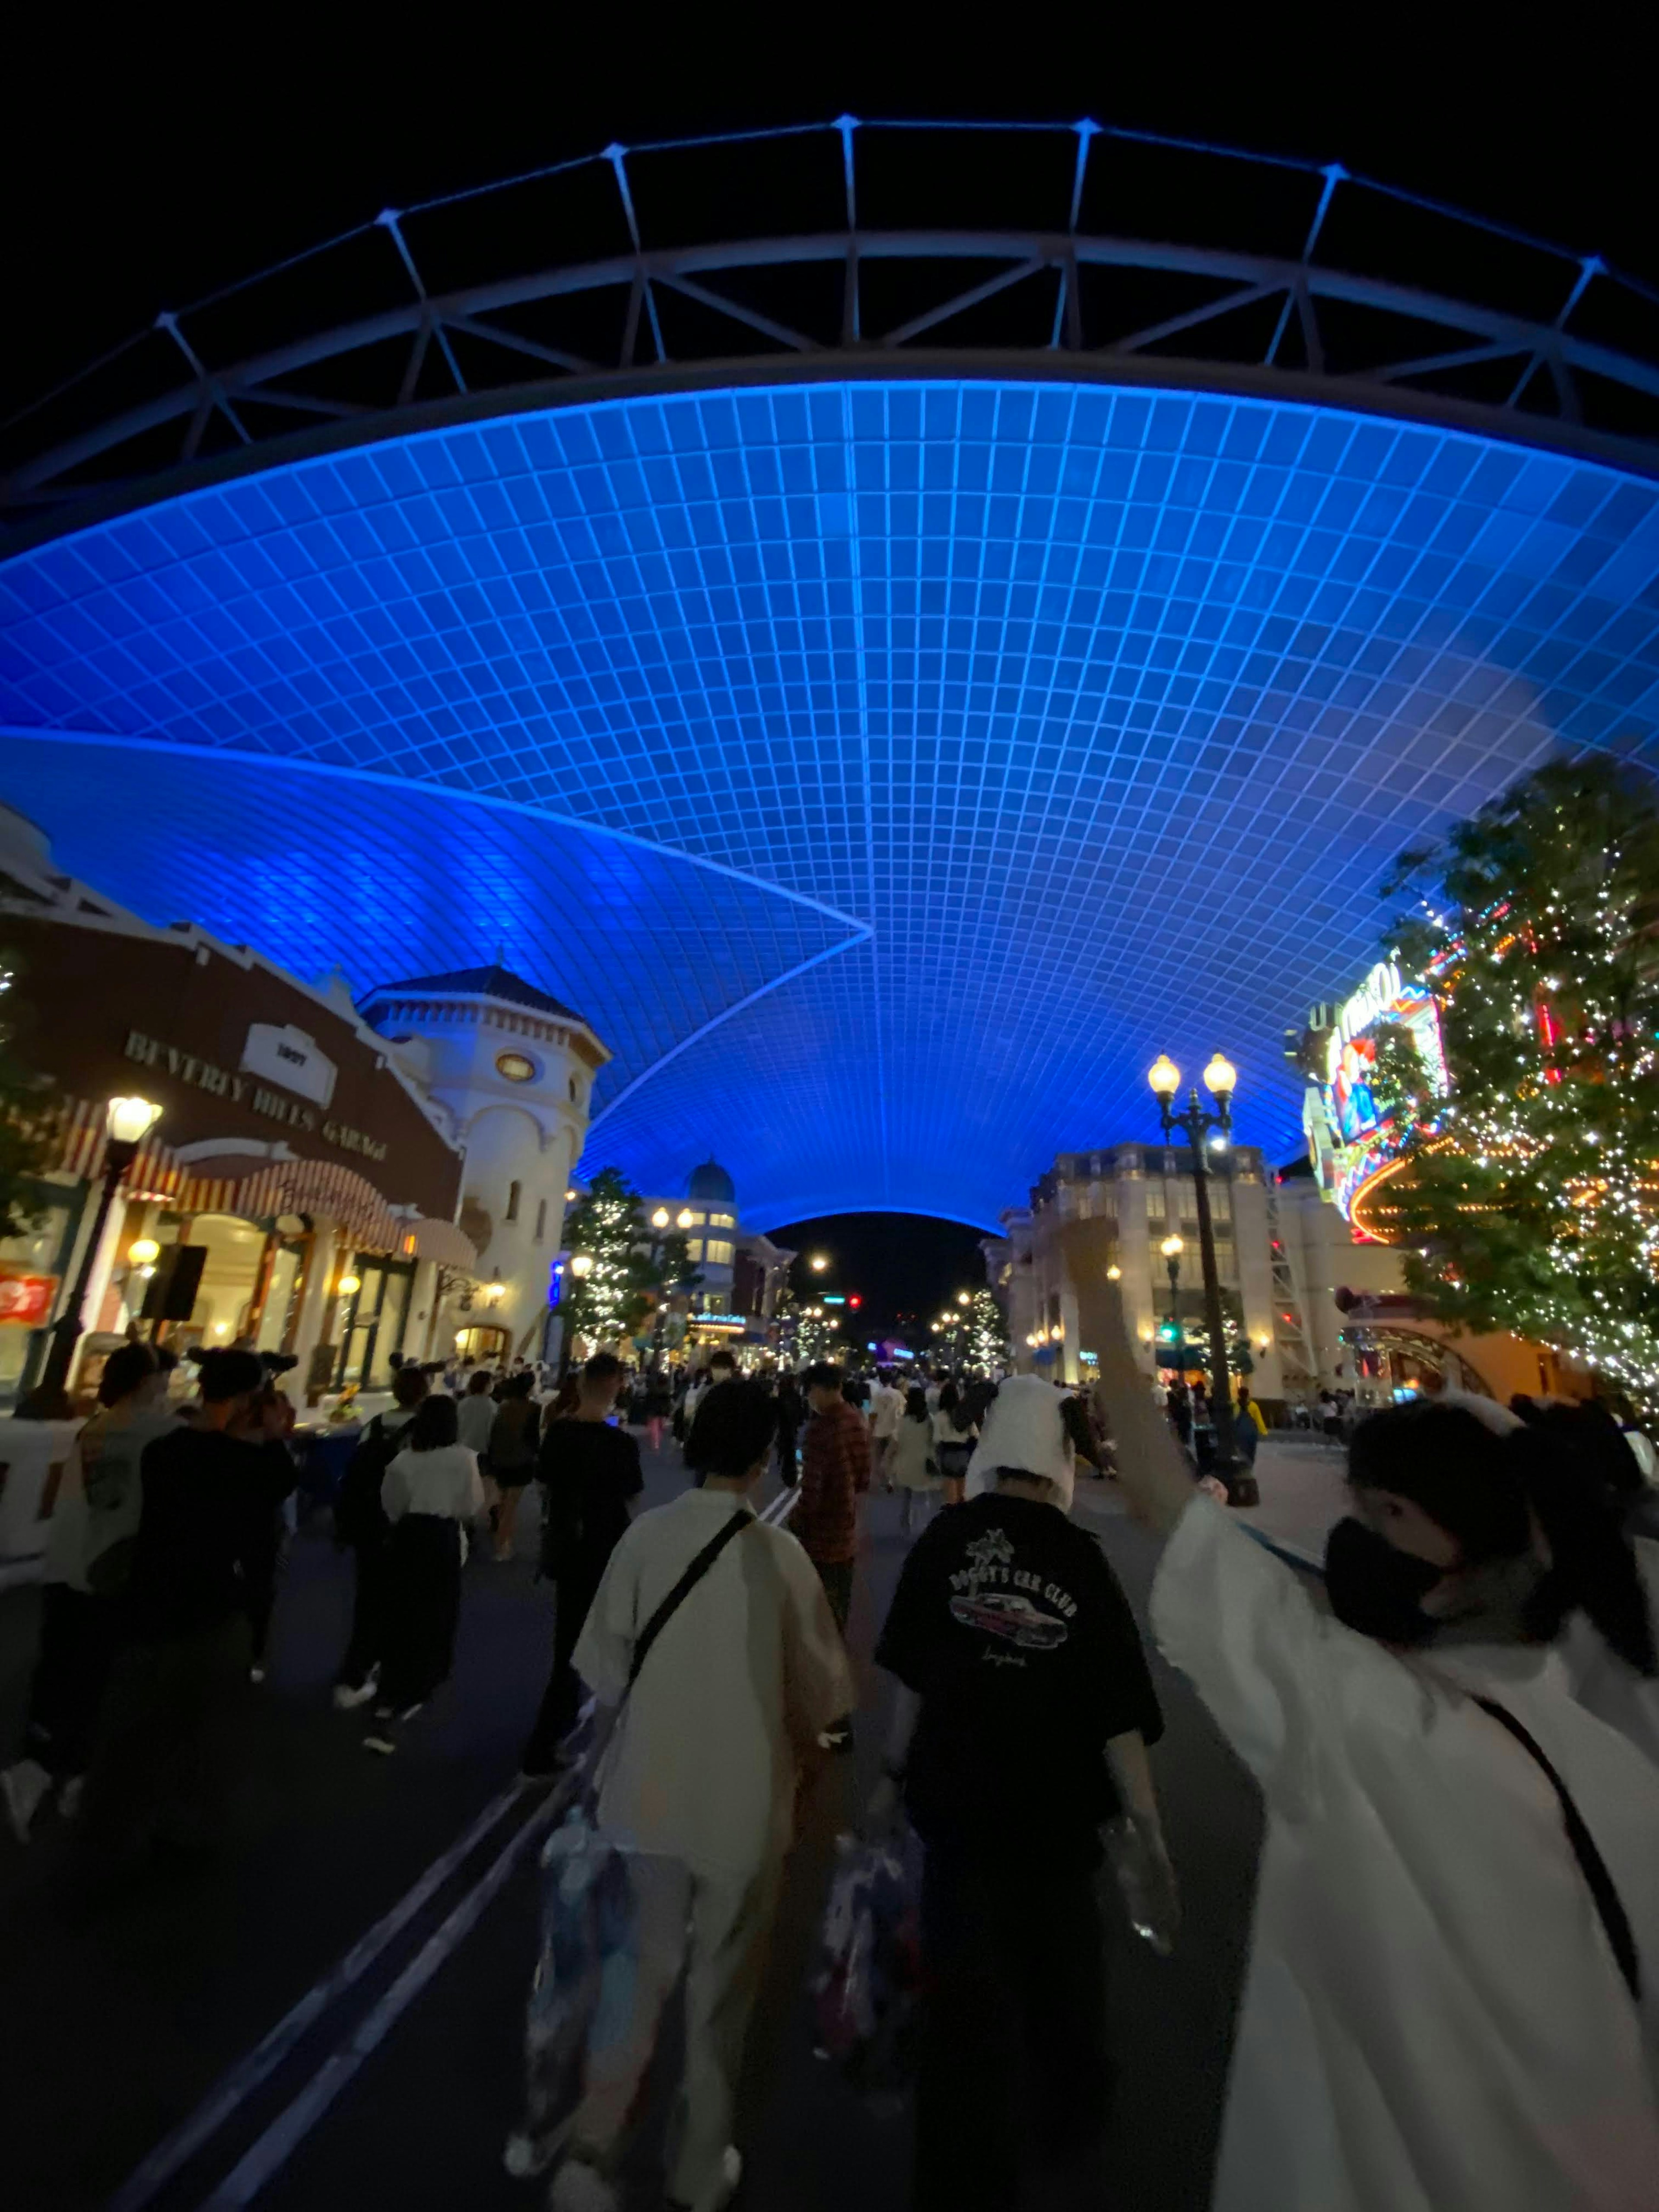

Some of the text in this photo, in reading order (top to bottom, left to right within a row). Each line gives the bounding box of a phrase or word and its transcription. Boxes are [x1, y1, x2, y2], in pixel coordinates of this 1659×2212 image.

[124, 1030, 254, 1102] BEVERLY
[1013, 1570, 1042, 1592] CAR
[1044, 1583, 1078, 1617] CLUB
